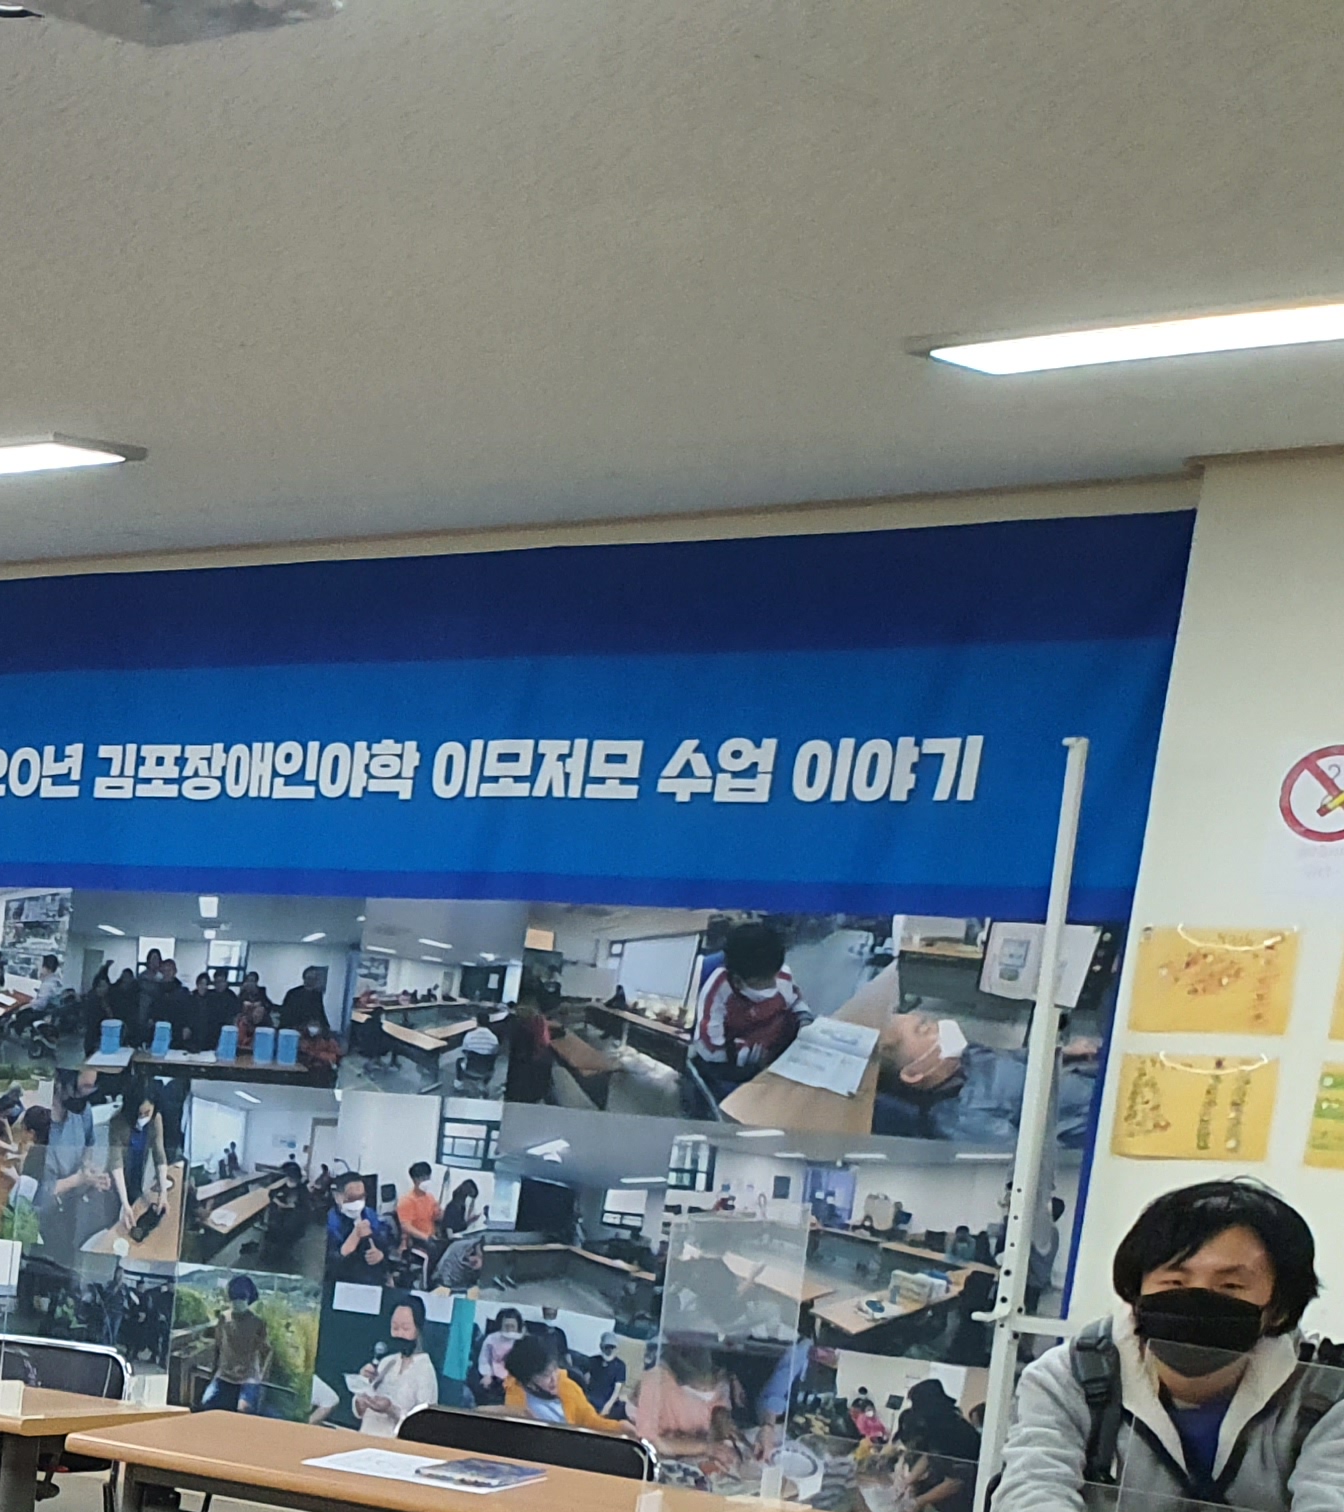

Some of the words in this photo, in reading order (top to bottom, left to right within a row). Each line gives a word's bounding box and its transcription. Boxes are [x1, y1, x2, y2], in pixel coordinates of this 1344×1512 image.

[94, 739, 420, 800] 김포장애인야학
[432, 737, 644, 799] 이모저모
[657, 736, 778, 803] 수업
[792, 734, 985, 802] 이야기
